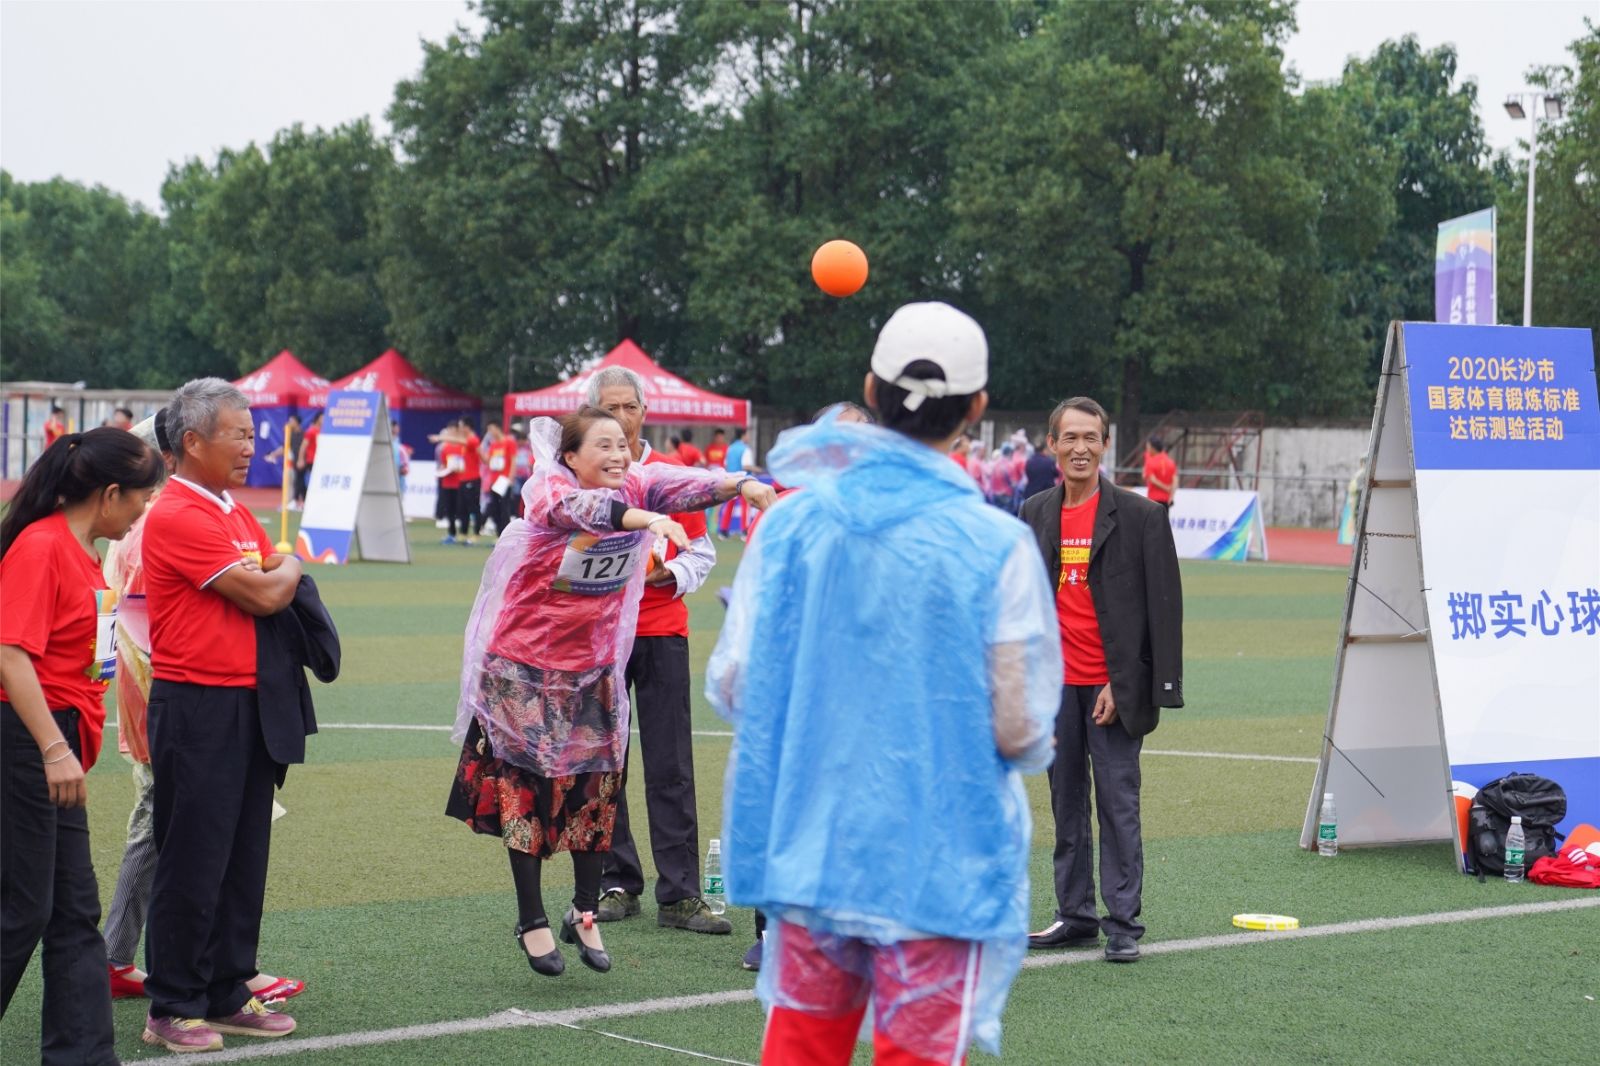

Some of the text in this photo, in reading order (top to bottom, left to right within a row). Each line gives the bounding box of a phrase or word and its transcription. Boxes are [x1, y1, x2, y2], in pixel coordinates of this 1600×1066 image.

[1448, 356, 1555, 382] 2020长沙市
[1428, 385, 1581, 412] 国家体育锻炼标准
[1449, 416, 1564, 441] 达标测验活动
[581, 552, 631, 579] 127
[1447, 587, 1600, 640] 掷实心球
